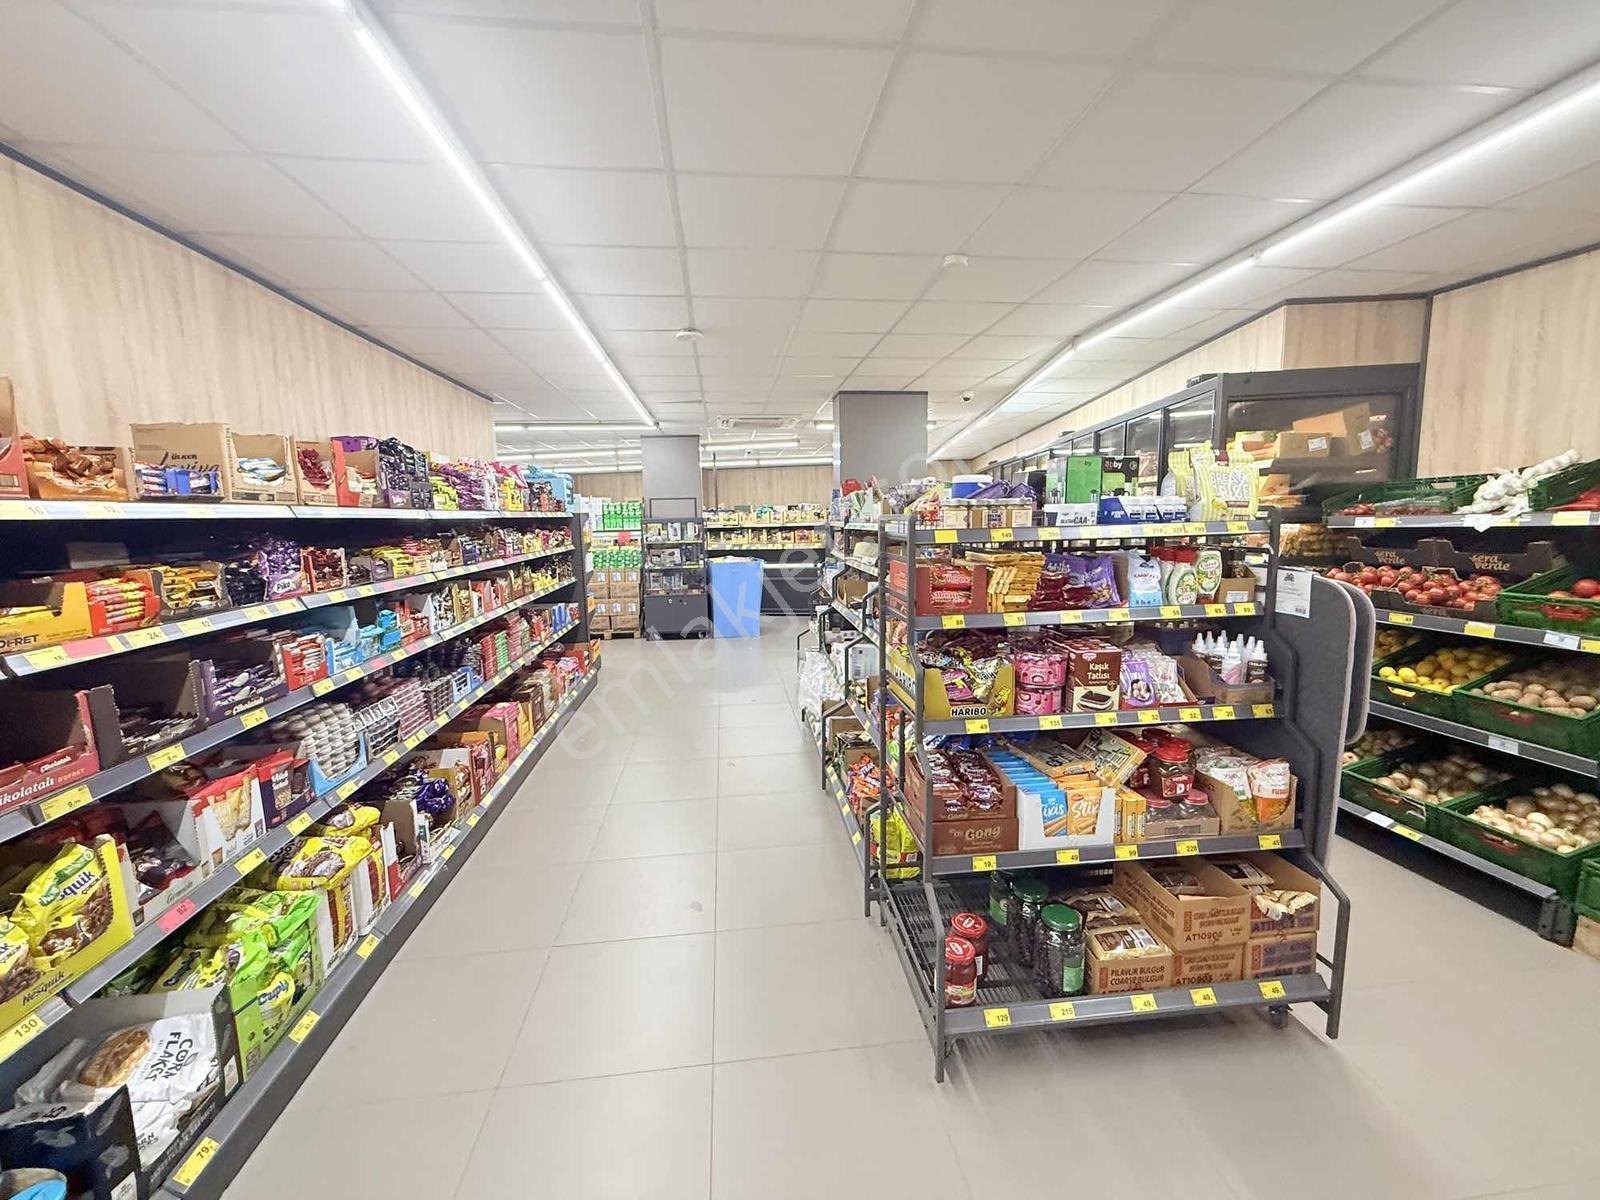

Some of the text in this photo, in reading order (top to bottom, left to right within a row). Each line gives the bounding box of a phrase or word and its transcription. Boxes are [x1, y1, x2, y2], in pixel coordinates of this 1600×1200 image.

[1377, 556, 1406, 565] verde
[1471, 554, 1498, 563] sera
[1475, 560, 1511, 571] verde
[951, 706, 988, 717] HARIBO
[965, 826, 1001, 841] Gong
[996, 1013, 1009, 1023] 129
[1061, 1008, 1074, 1017] 215
[14, 1018, 39, 1038] 130
[144, 1031, 182, 1082] FLAKES
[162, 1038, 194, 1079] CORN
